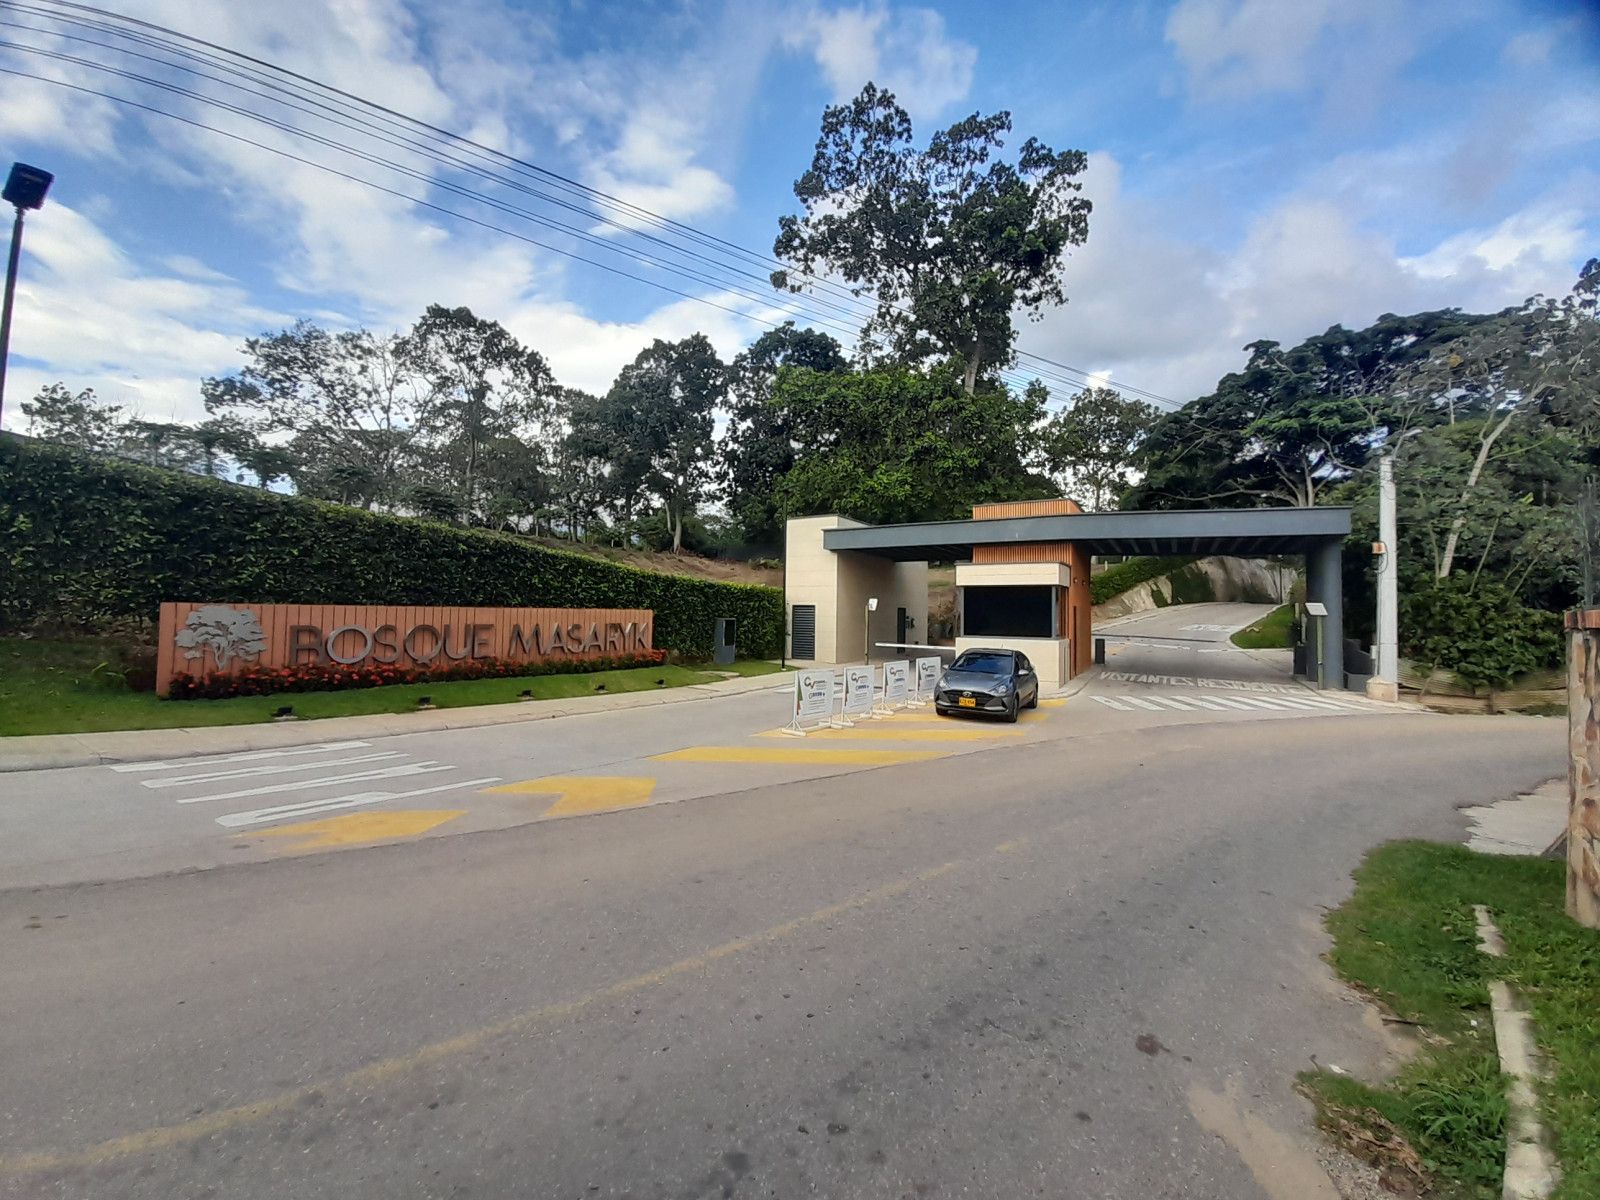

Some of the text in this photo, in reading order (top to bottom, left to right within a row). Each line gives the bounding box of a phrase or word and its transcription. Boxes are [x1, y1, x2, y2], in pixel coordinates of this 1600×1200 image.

[289, 621, 650, 667] BOSQUE MASARYK
[1099, 671, 1195, 687] VISITANTES
